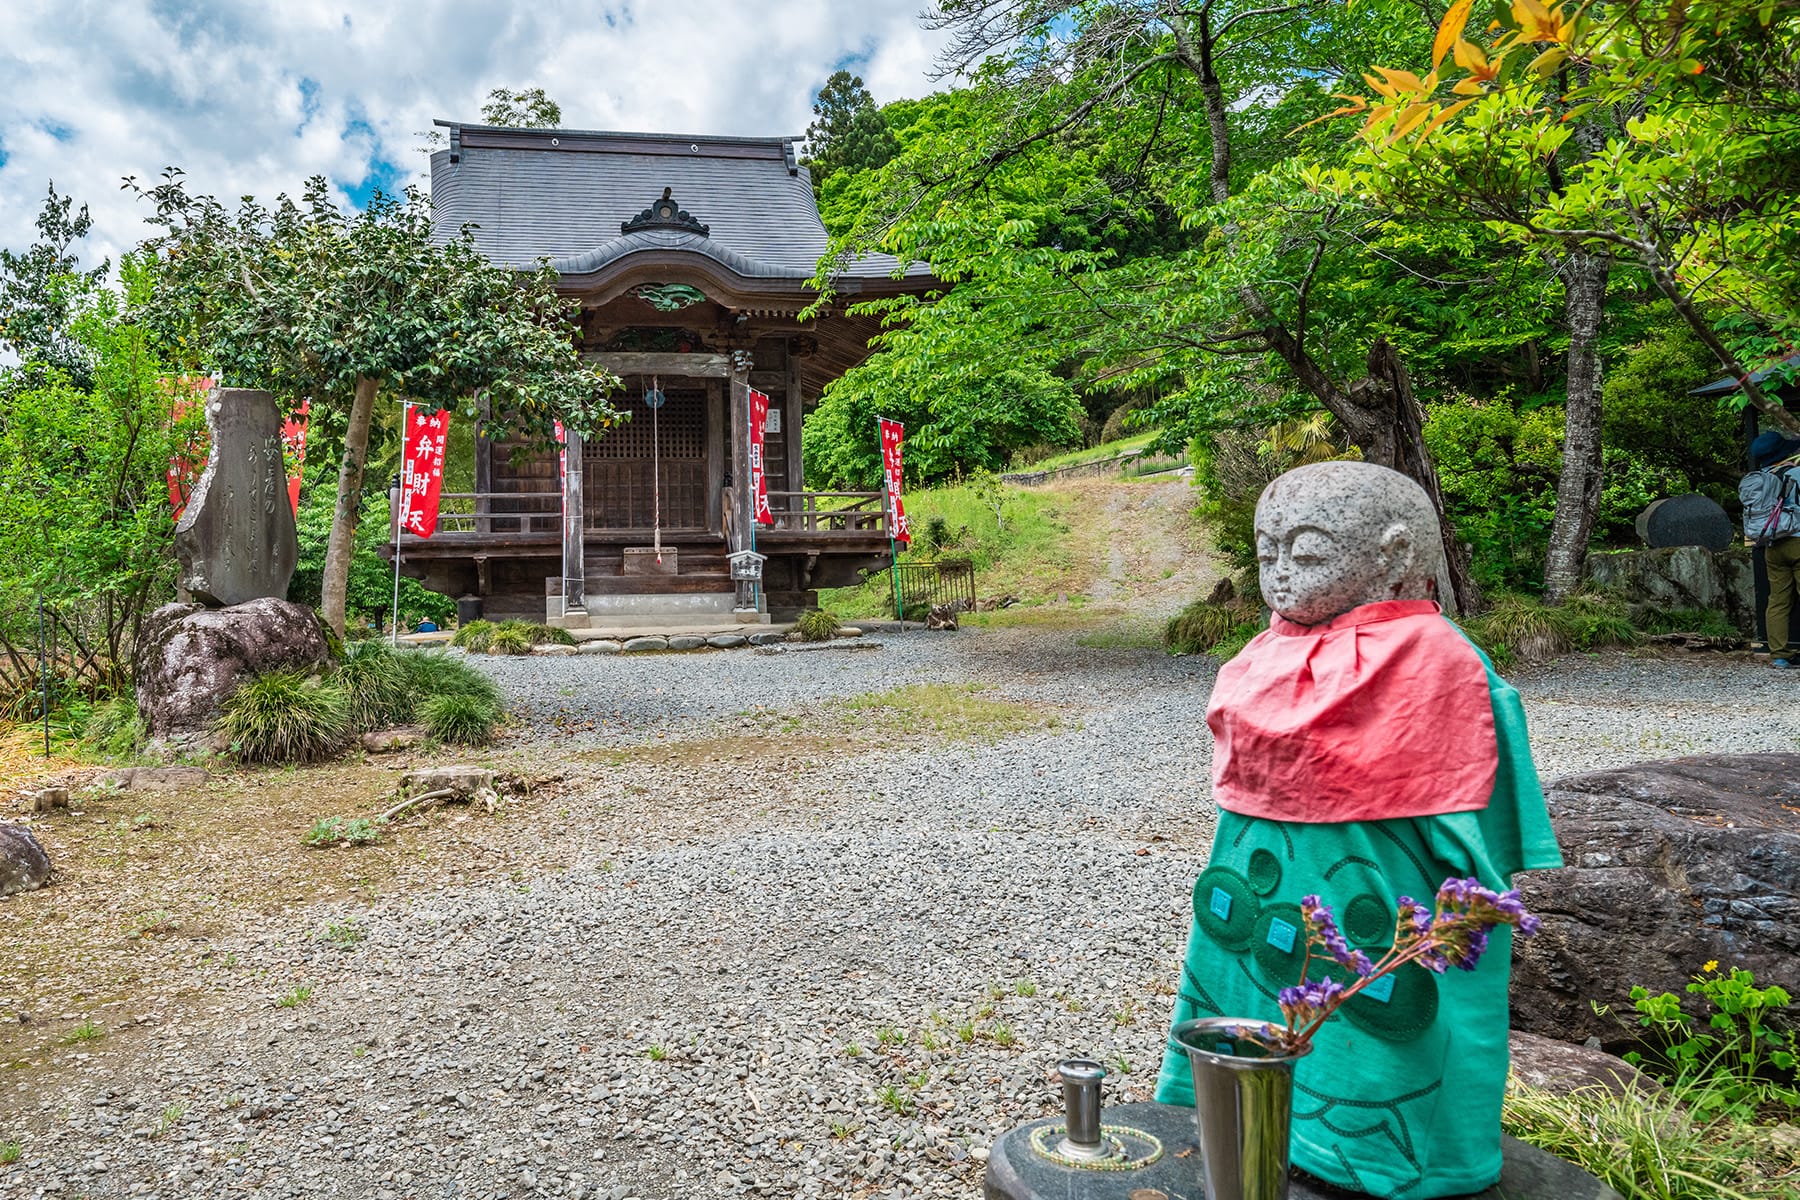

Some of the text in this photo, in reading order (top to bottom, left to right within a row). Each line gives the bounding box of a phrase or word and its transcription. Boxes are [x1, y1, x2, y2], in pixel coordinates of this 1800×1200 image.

[416, 415, 441, 429] 奉納
[432, 435, 446, 477] 開運招福
[409, 435, 435, 532] 弁財天
